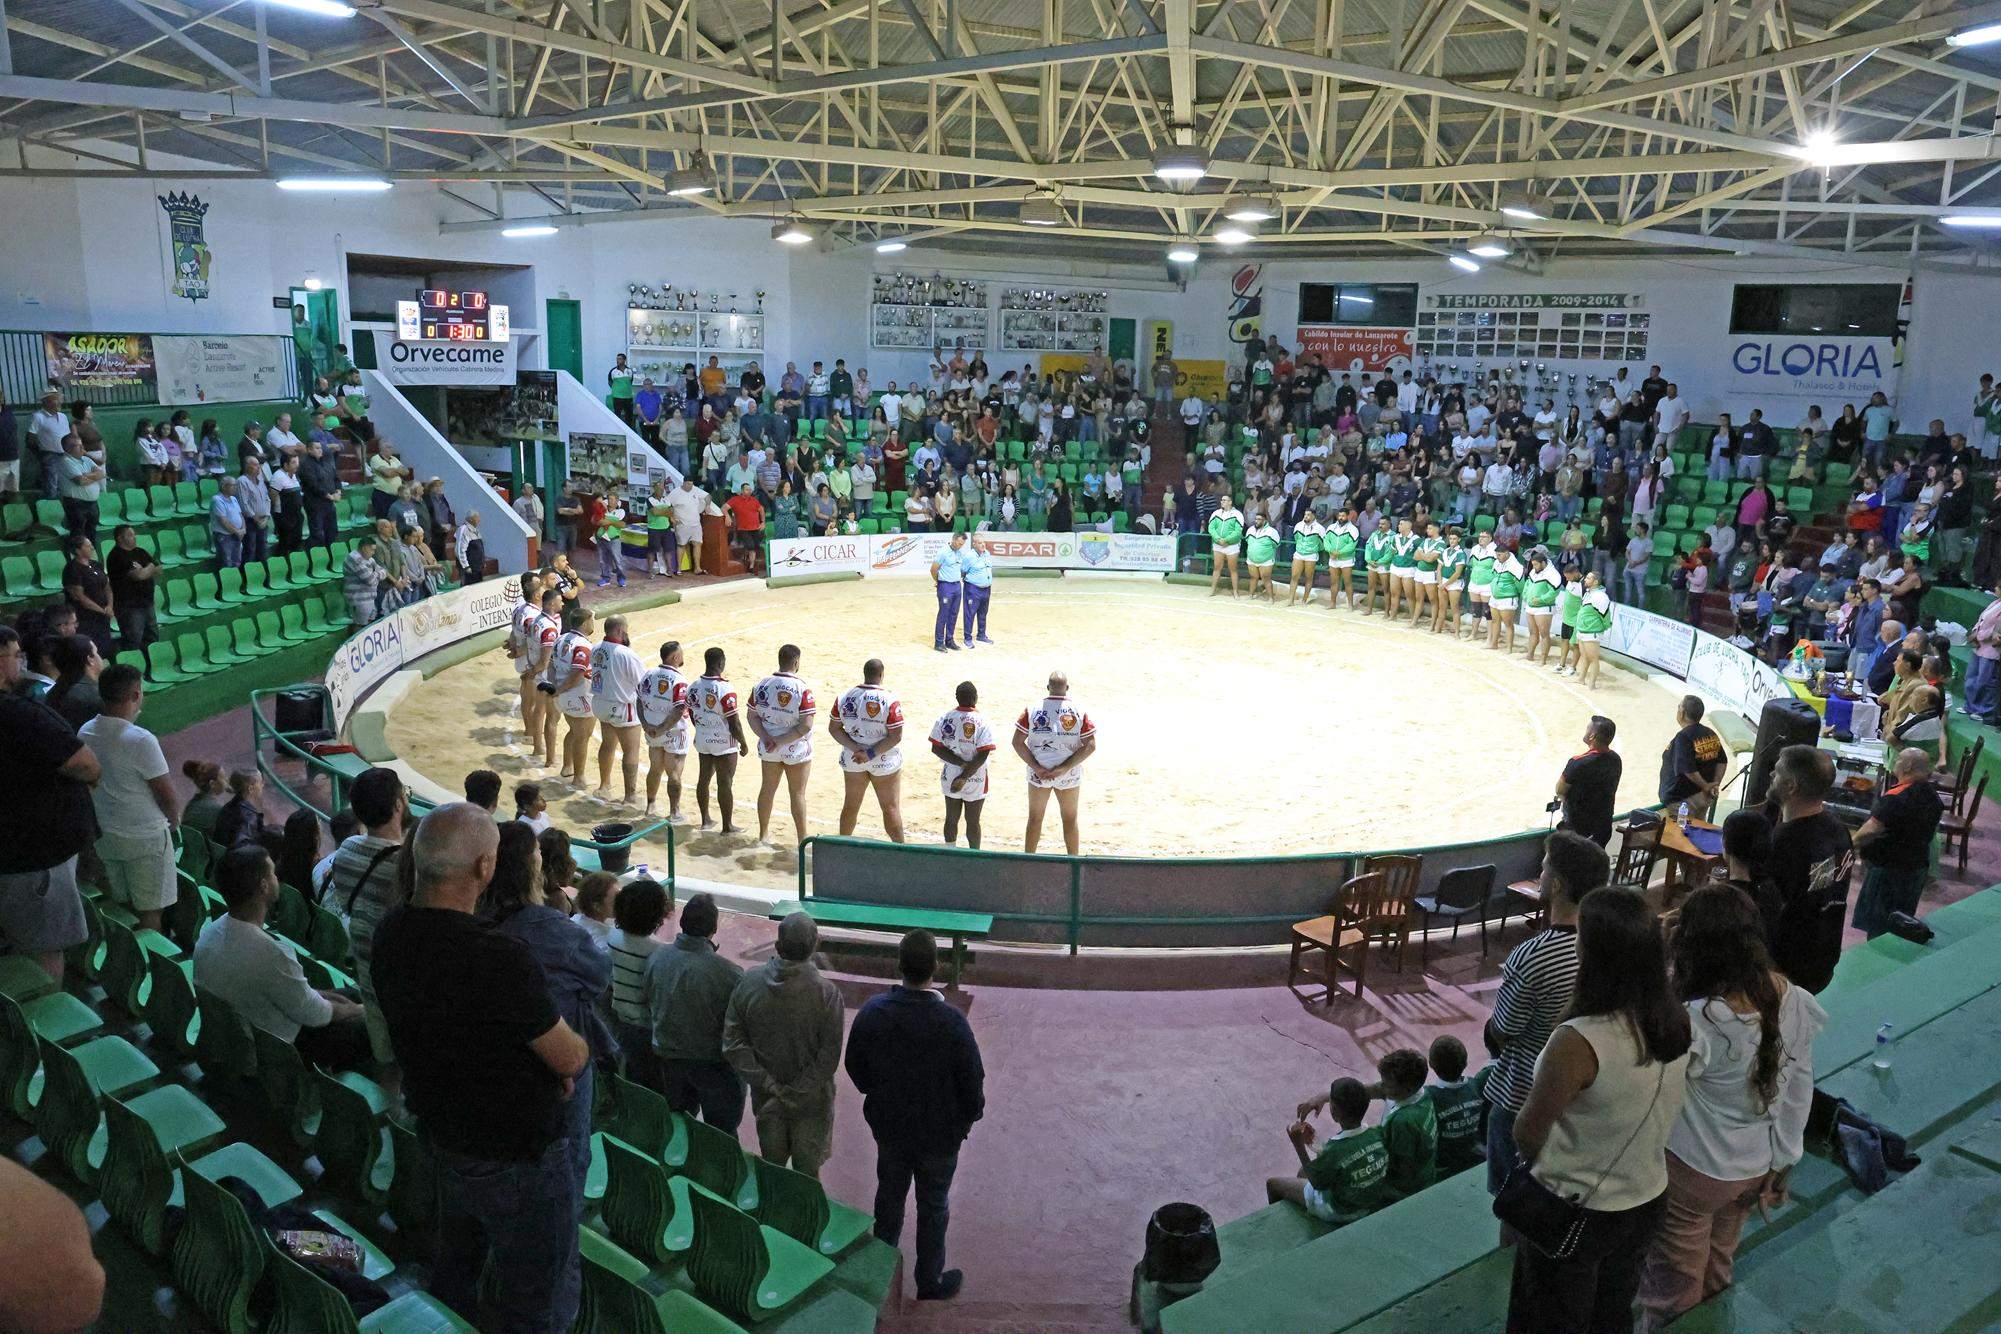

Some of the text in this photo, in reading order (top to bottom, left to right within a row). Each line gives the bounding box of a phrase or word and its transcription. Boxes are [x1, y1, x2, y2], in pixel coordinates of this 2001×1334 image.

[436, 292, 444, 306] 0
[450, 294, 458, 306] 2
[474, 293, 482, 308] 0
[1444, 295, 1619, 308] TEMPORADA 2009-2014
[427, 326, 434, 337] 0
[449, 324, 474, 338] 1:30
[476, 326, 483, 338] 0
[1304, 330, 1328, 338] Cabildo
[1330, 330, 1352, 339] Insular
[1364, 331, 1398, 340] Lanzarote
[68, 336, 128, 354] ASADOR
[1308, 338, 1397, 354] con lo nuestro
[390, 342, 505, 363] Orvecame
[1733, 342, 1882, 378] GLORIA
[1838, 382, 1845, 390] &
[814, 544, 856, 560] CICAR
[992, 543, 1054, 556] SPAR
[470, 594, 502, 614] COLEGIO
[350, 622, 400, 673] GLORIA
[1713, 641, 1721, 654] DE
